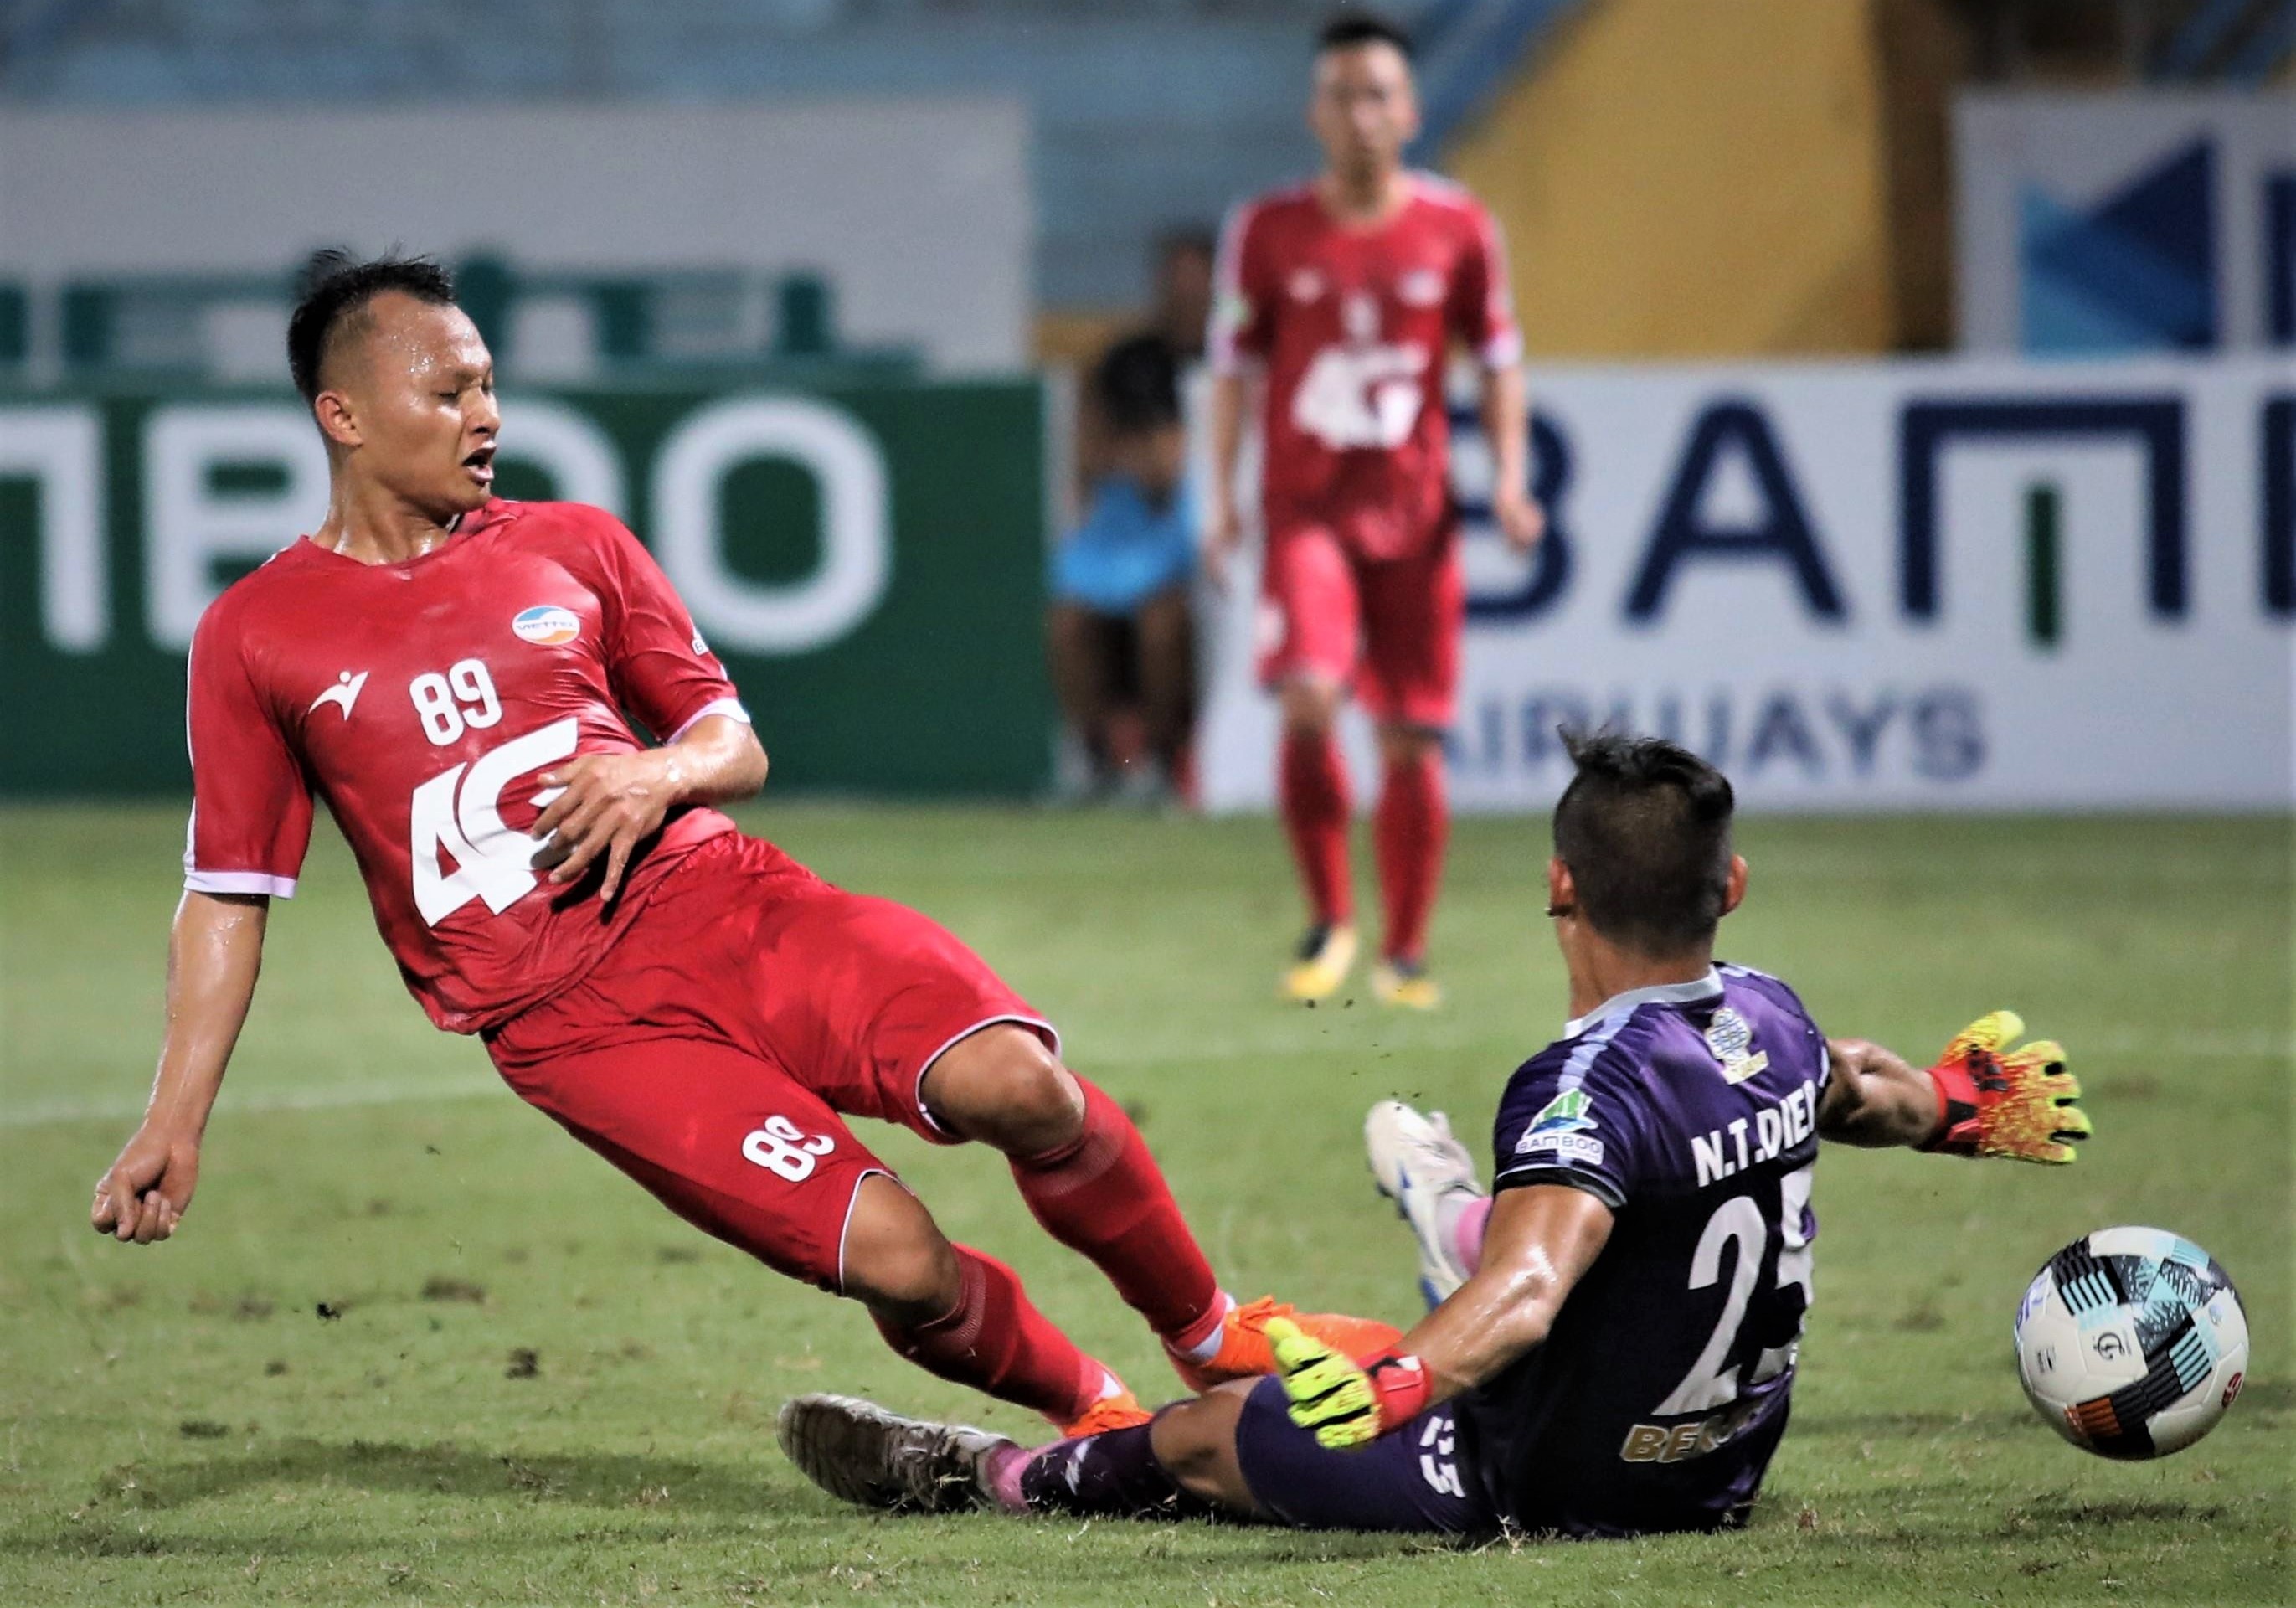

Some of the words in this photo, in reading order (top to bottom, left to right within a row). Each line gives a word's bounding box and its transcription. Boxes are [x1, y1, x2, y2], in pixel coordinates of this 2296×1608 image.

[1292, 345, 1427, 448] 4G
[1444, 394, 2296, 647] BAM
[409, 658, 502, 746] 89
[410, 716, 579, 928] 4G
[1518, 1136, 1599, 1154] BAMBOO
